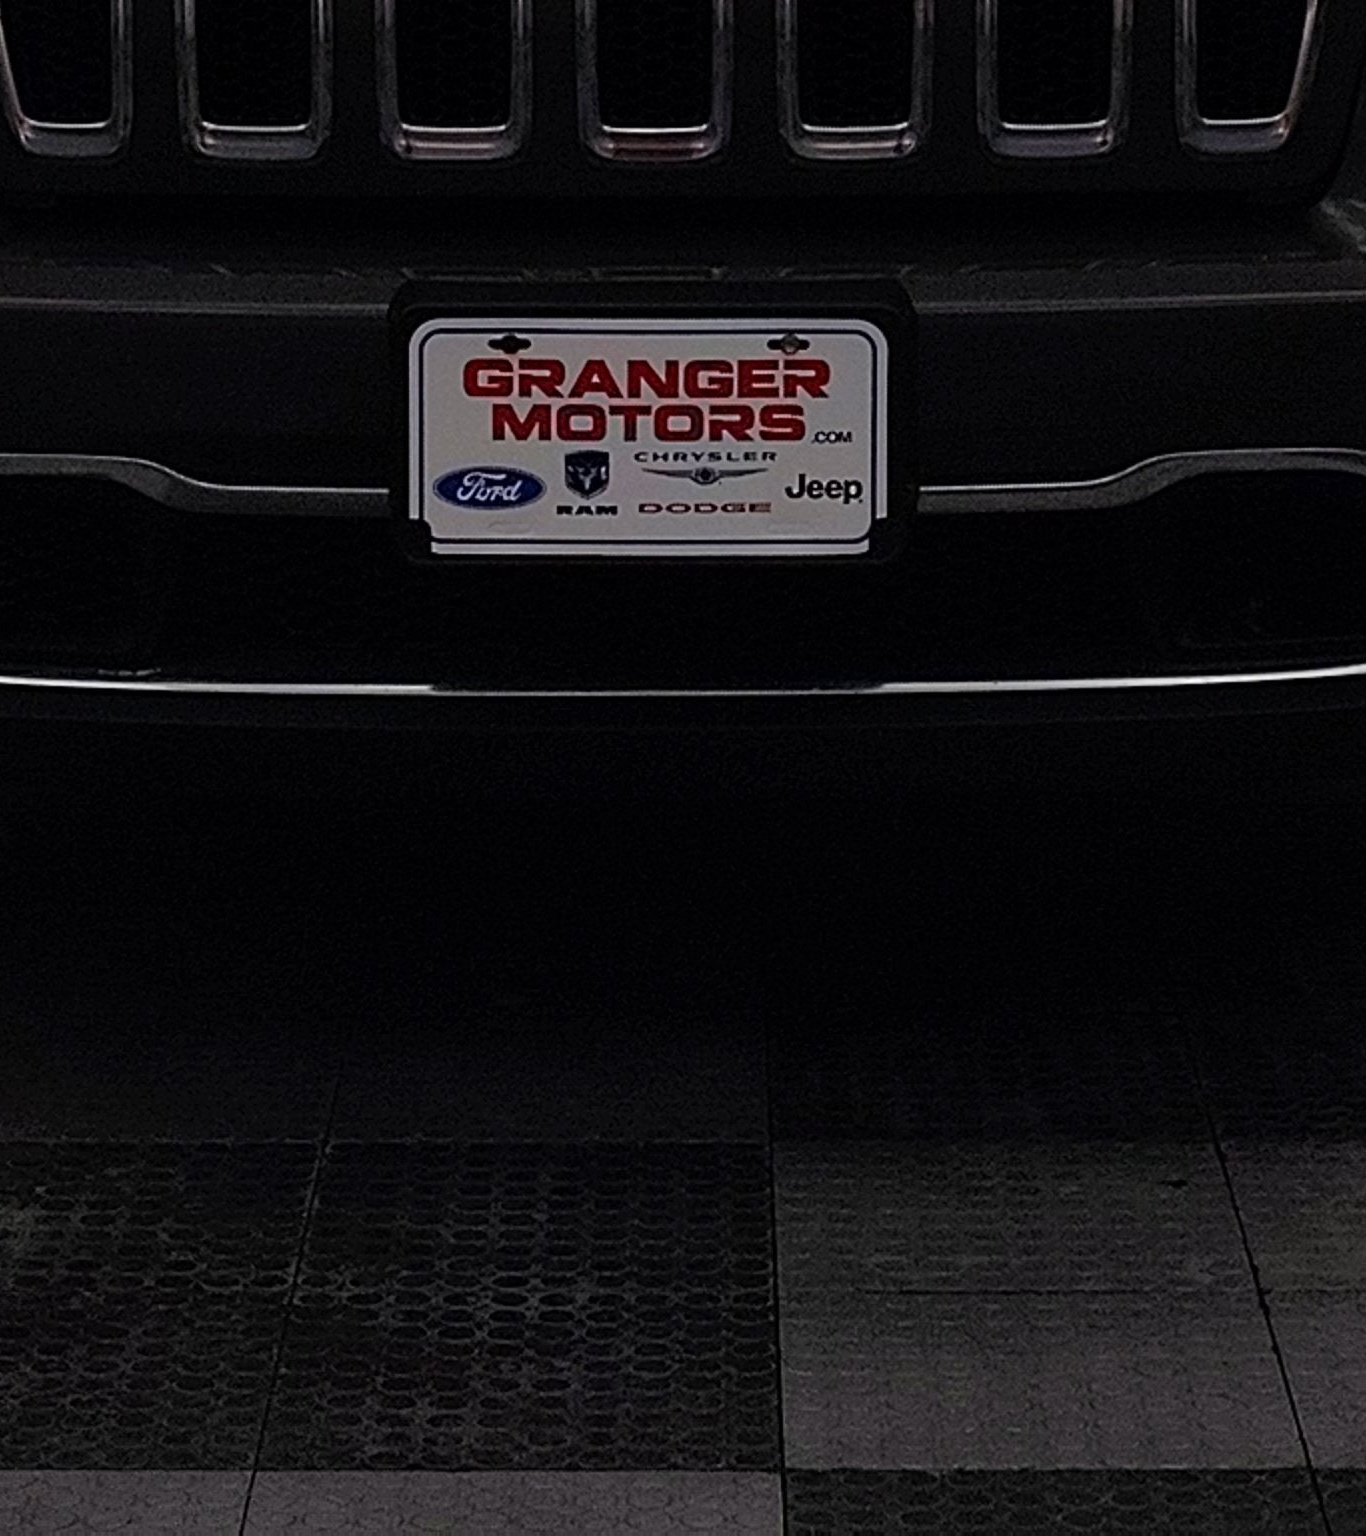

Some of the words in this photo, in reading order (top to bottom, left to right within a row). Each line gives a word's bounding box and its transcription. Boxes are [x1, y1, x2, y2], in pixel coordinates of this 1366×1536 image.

[462, 358, 831, 399] GRANGER
[491, 404, 806, 442] MOTORS
[633, 450, 778, 463] CHRYSLER
[455, 471, 523, 503] Ford
[784, 473, 863, 504] Jeep
[555, 504, 618, 516] RAM
[637, 502, 773, 514] DODGE
